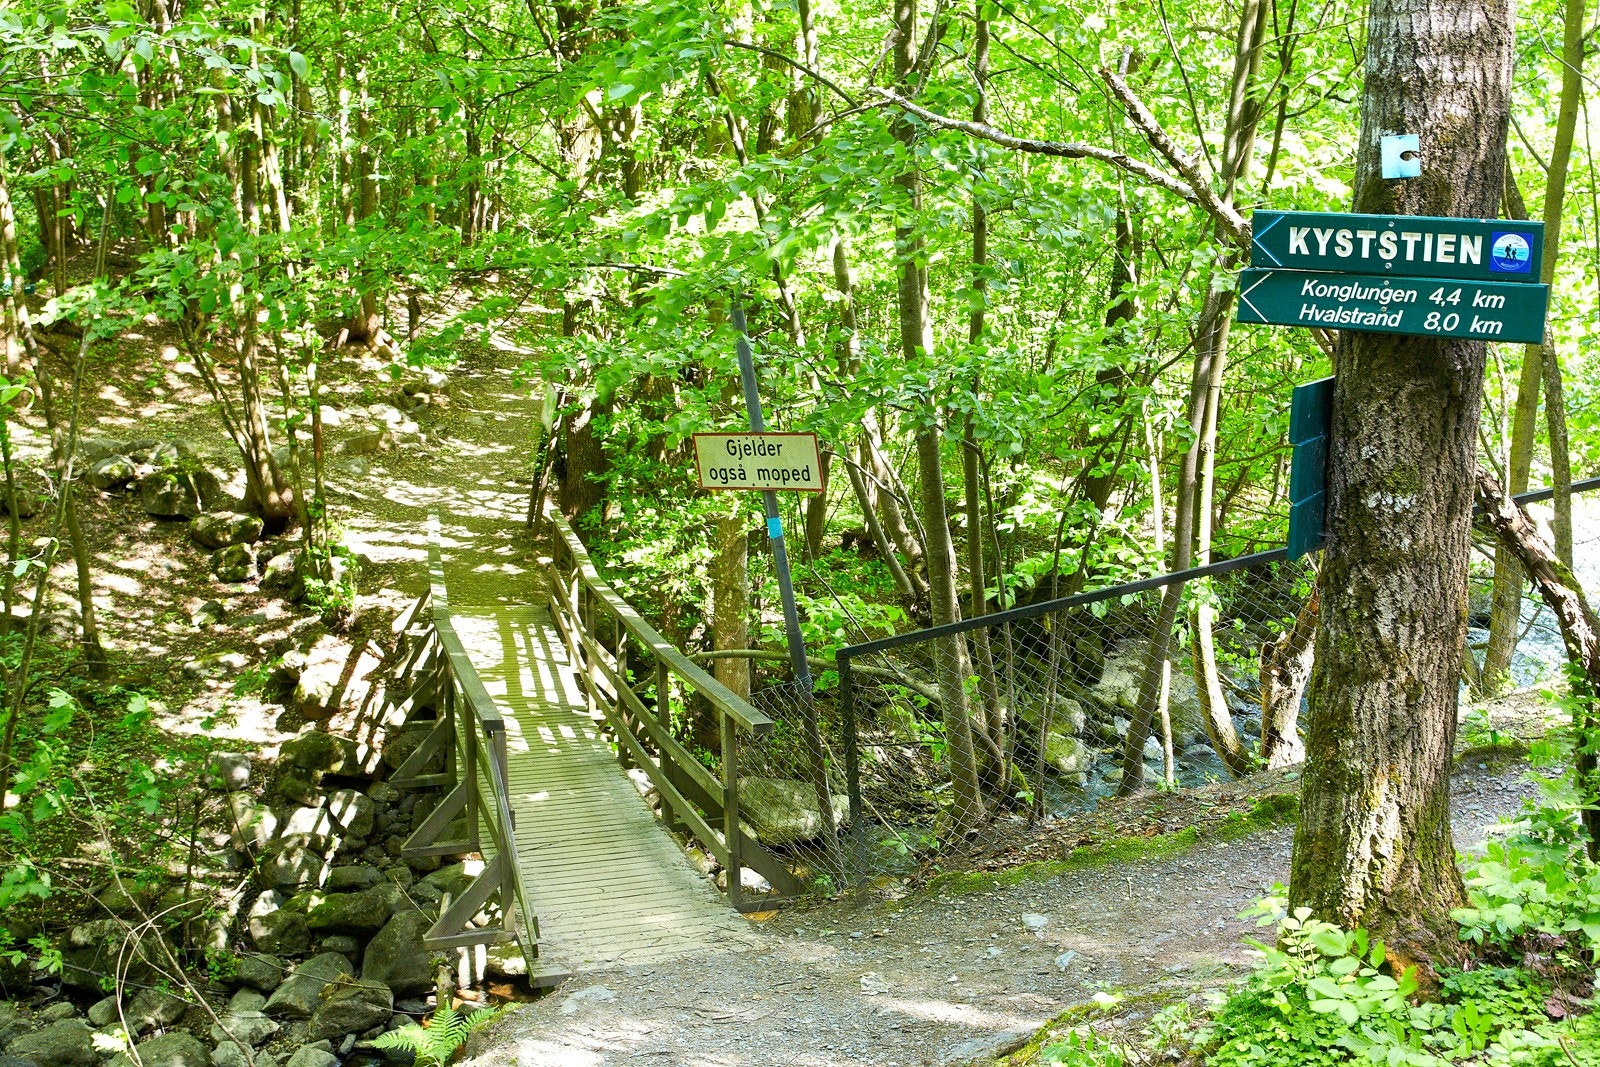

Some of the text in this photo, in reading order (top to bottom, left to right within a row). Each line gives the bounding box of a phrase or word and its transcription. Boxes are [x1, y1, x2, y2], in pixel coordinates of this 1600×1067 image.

[1288, 227, 1483, 265] KYSTSTIEN
[1300, 279, 1506, 309] Konglungen 4,4 km
[1299, 304, 1503, 335] Hvalstrand 8,0 km
[726, 439, 782, 460] Gjelder
[709, 464, 811, 485] også moped
